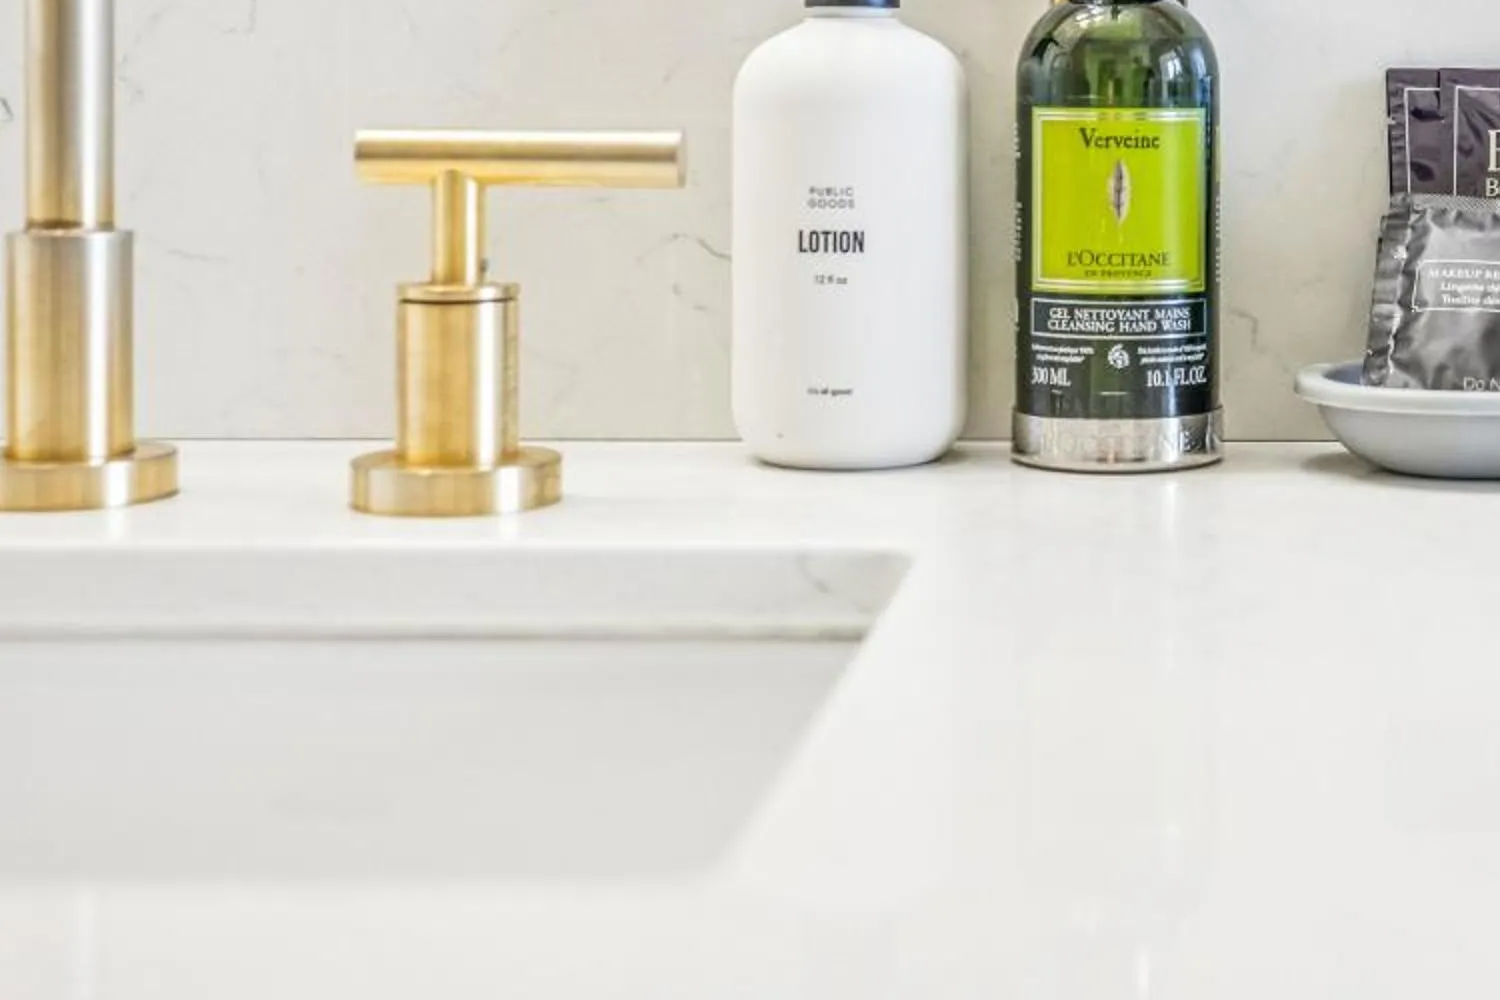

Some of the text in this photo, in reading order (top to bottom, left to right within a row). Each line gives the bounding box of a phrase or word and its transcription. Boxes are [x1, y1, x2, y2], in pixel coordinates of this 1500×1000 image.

[1079, 127, 1160, 149] Verveine
[808, 186, 854, 197] PUBLIC
[807, 198, 855, 209] GOODS
[798, 230, 865, 253] LOTION
[1428, 268, 1482, 280] MAKEUP
[1049, 307, 1191, 320] GEL NETTOYANT MAINS
[1047, 319, 1192, 333] CLEANSING HAND WASH
